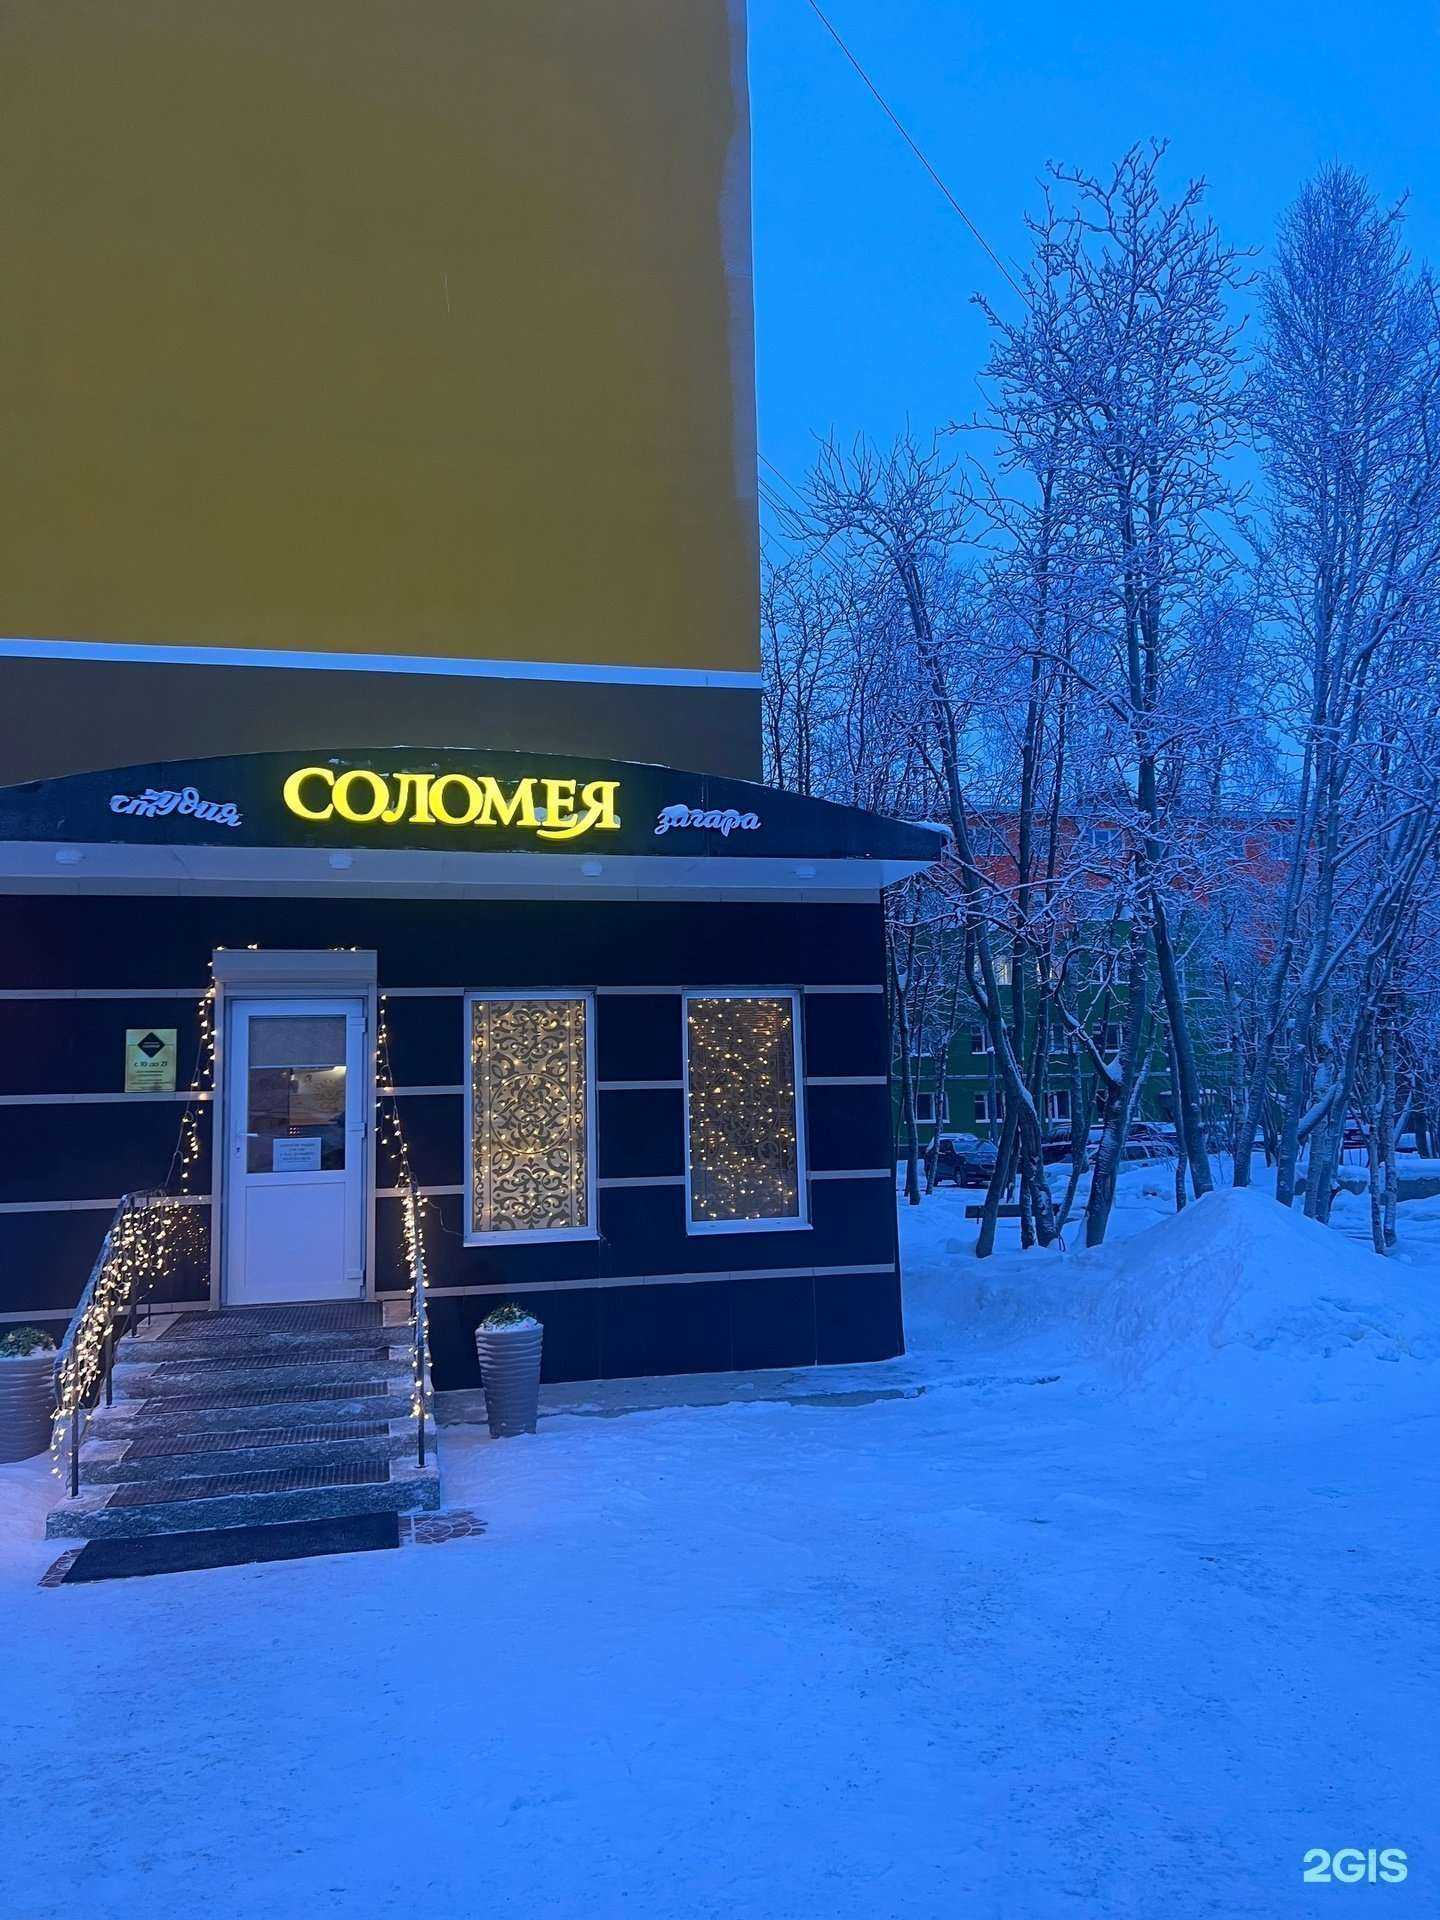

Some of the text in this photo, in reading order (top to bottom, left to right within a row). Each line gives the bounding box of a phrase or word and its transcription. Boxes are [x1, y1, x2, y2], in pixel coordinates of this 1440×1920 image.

[109, 767, 762, 840] студия СОЛОМЕЯ загара
